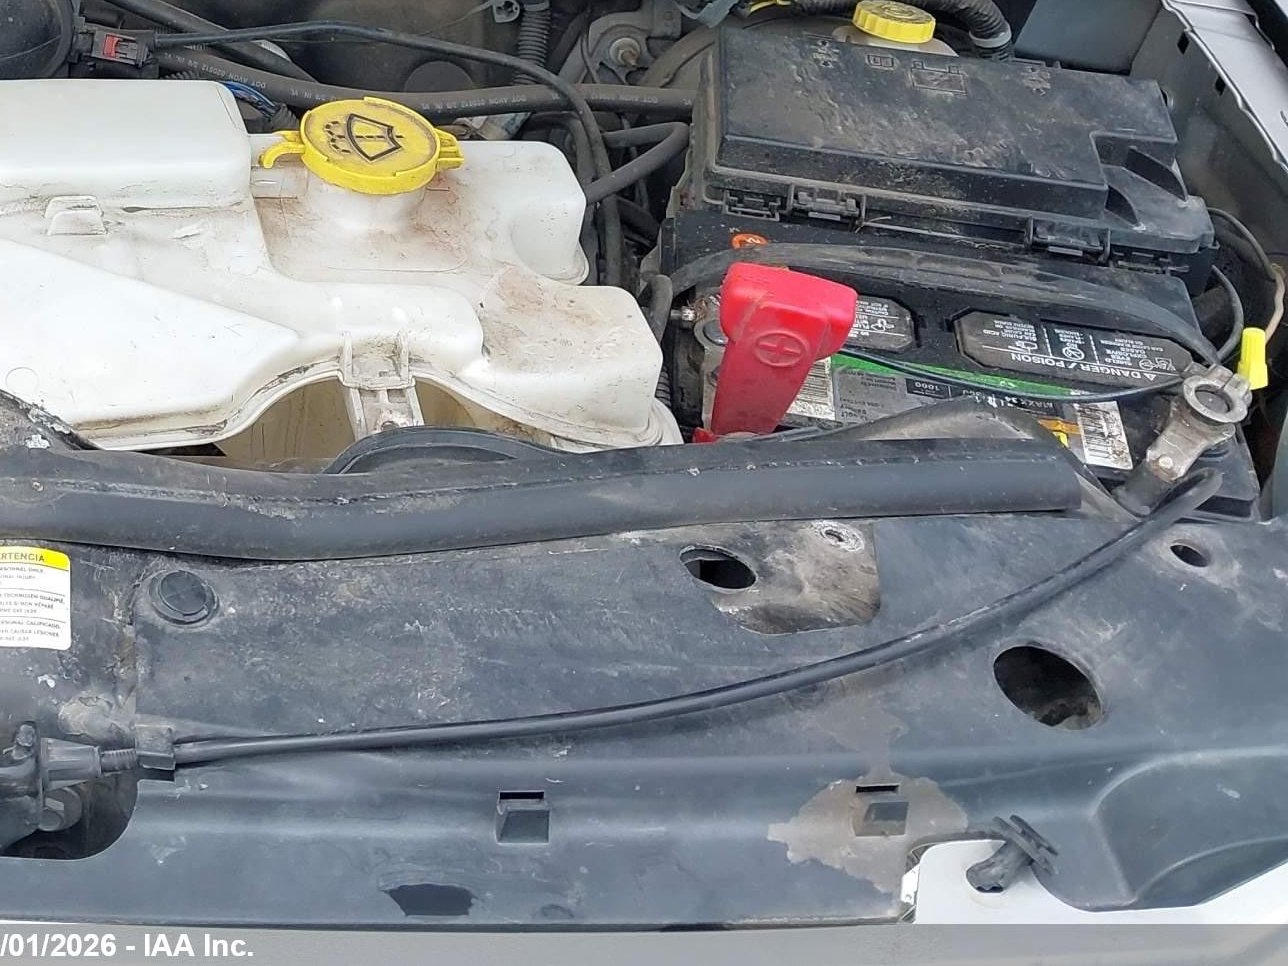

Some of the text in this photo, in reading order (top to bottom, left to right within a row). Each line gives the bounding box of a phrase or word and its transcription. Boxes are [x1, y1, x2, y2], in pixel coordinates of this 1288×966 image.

[228, 72, 248, 85] AVON
[252, 79, 266, 89] DOT
[1010, 353, 1065, 368] POISON
[1079, 362, 1142, 379] DANGER
[913, 380, 940, 391] 1000
